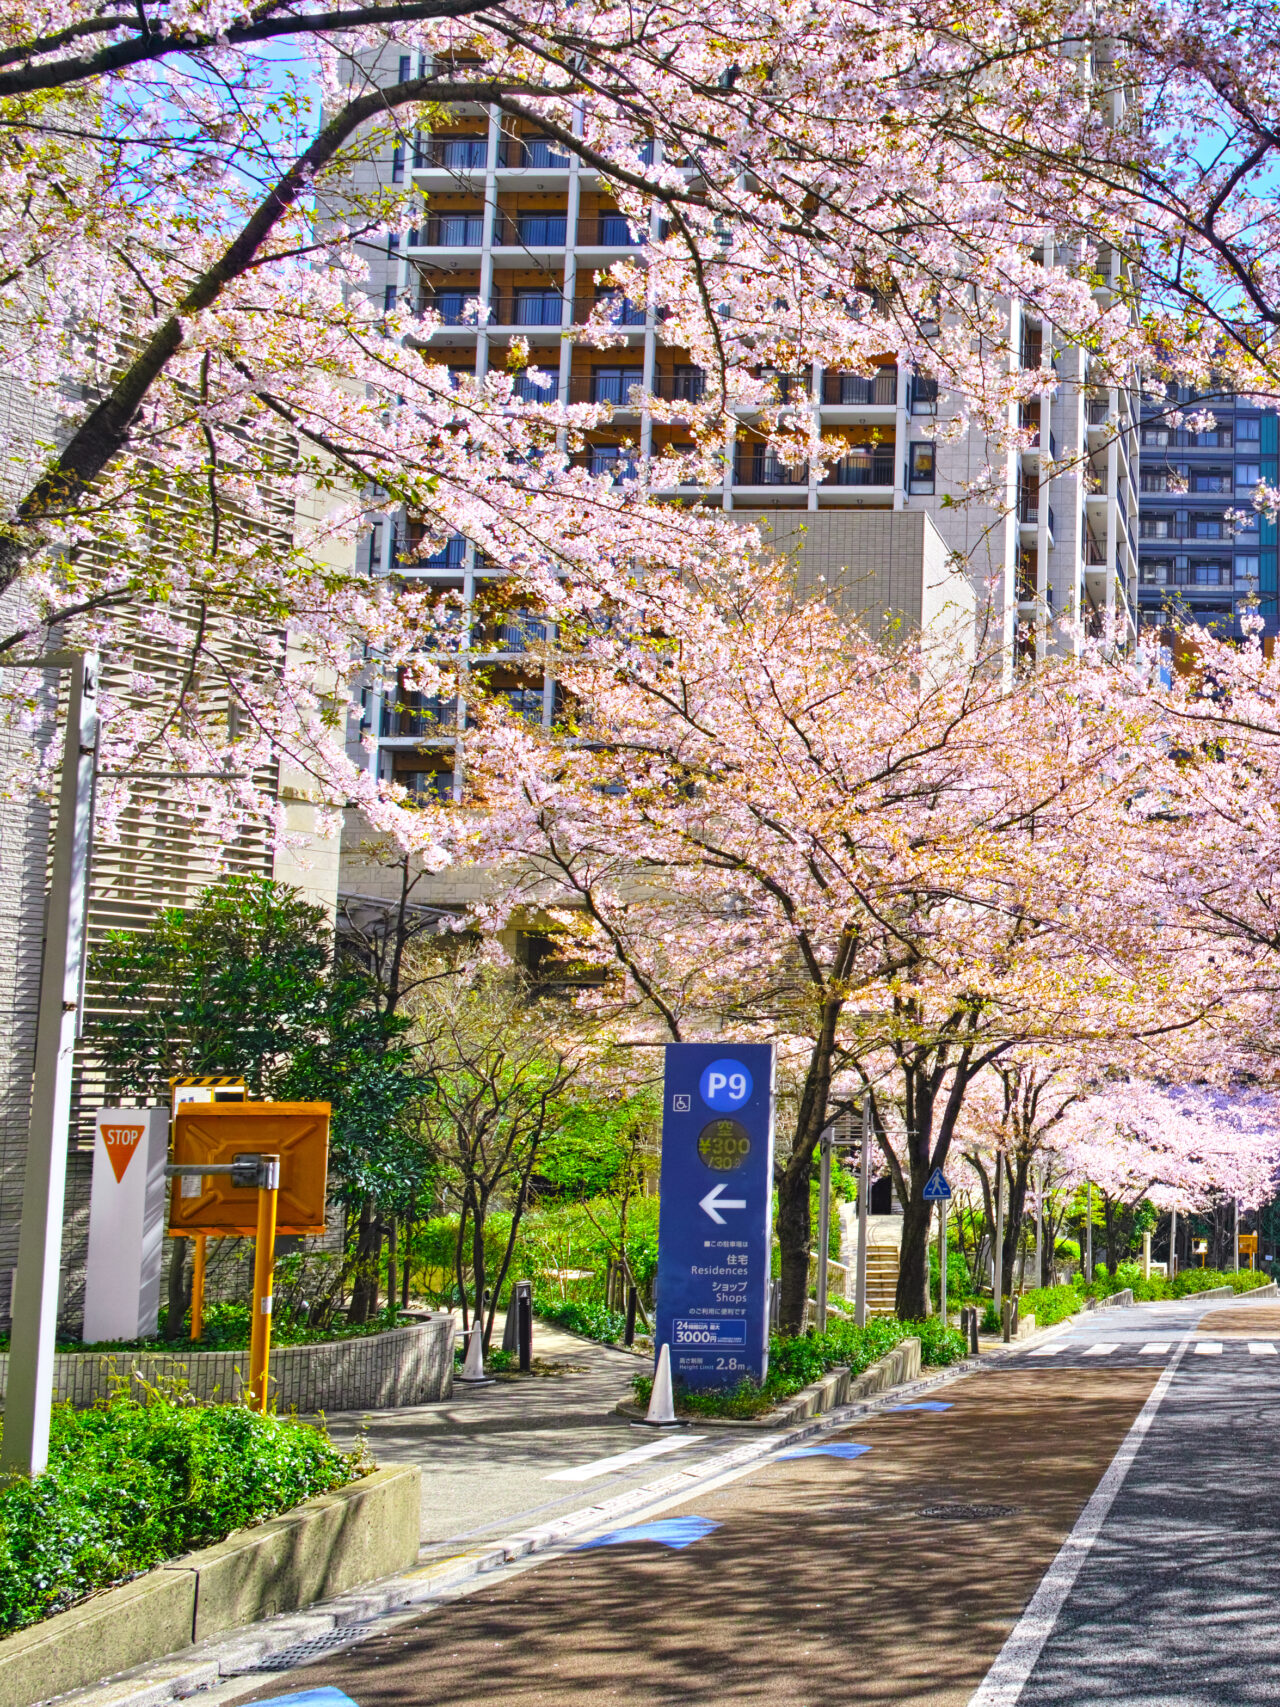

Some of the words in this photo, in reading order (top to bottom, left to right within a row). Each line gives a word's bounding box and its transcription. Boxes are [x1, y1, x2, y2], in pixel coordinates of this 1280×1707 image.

[708, 1072, 746, 1100] P9
[107, 1130, 138, 1145] STOP
[698, 1137, 751, 1155] ¥300
[727, 1254, 748, 1265] 住宅
[691, 1265, 748, 1276] Residences
[712, 1281, 748, 1292] ショップ
[716, 1292, 747, 1304] Shops
[676, 1331, 717, 1343] 3000円
